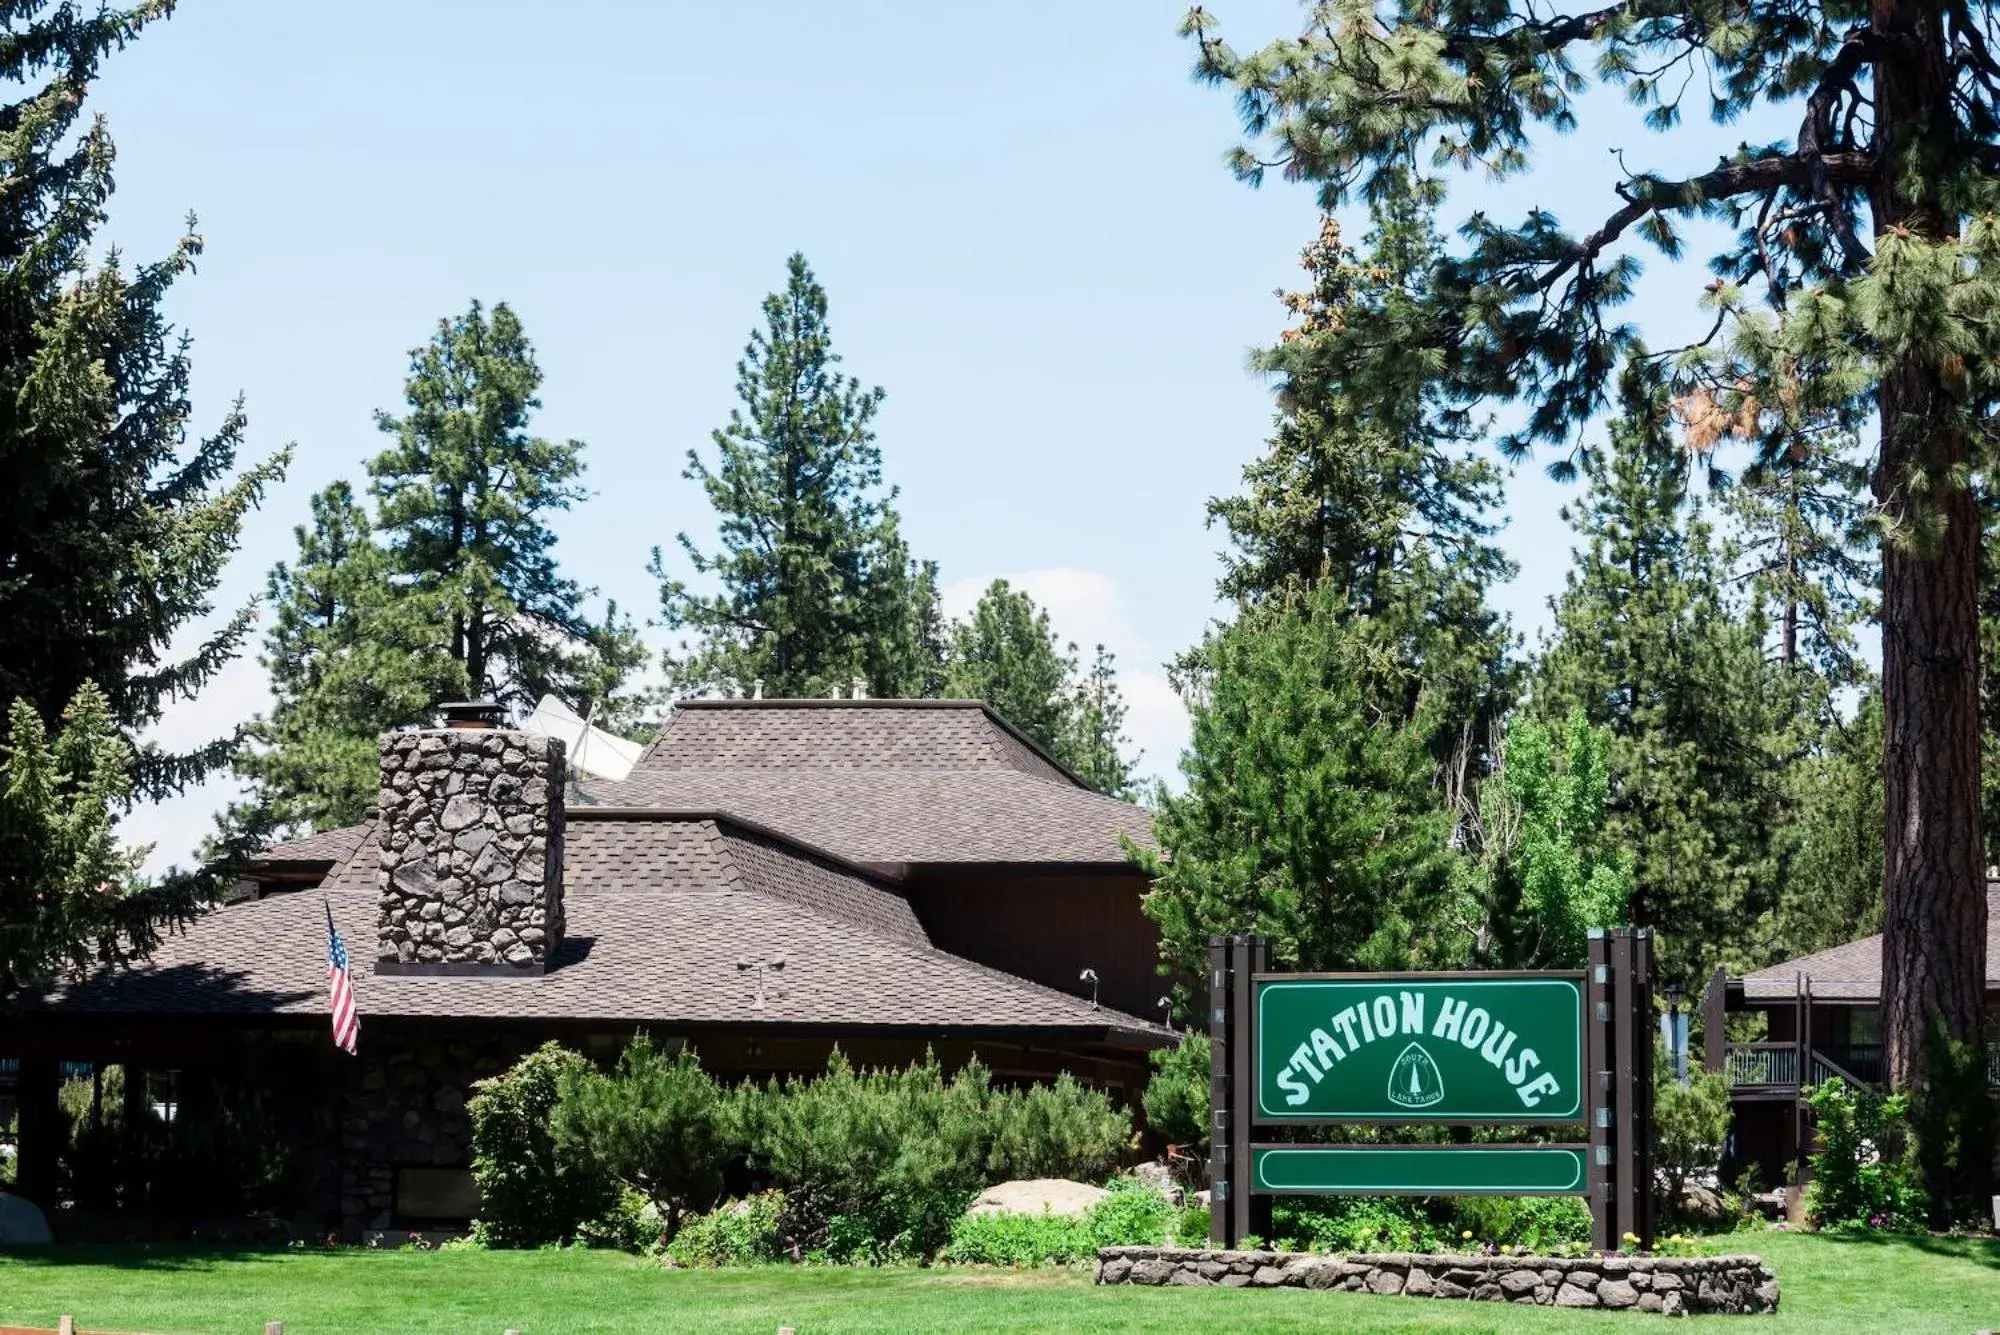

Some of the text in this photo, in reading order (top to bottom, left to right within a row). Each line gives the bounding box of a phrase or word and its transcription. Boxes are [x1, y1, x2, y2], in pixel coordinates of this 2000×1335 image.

[1276, 991, 1560, 1108] STATION HOUSE
[1400, 1053, 1429, 1066] SOUTH
